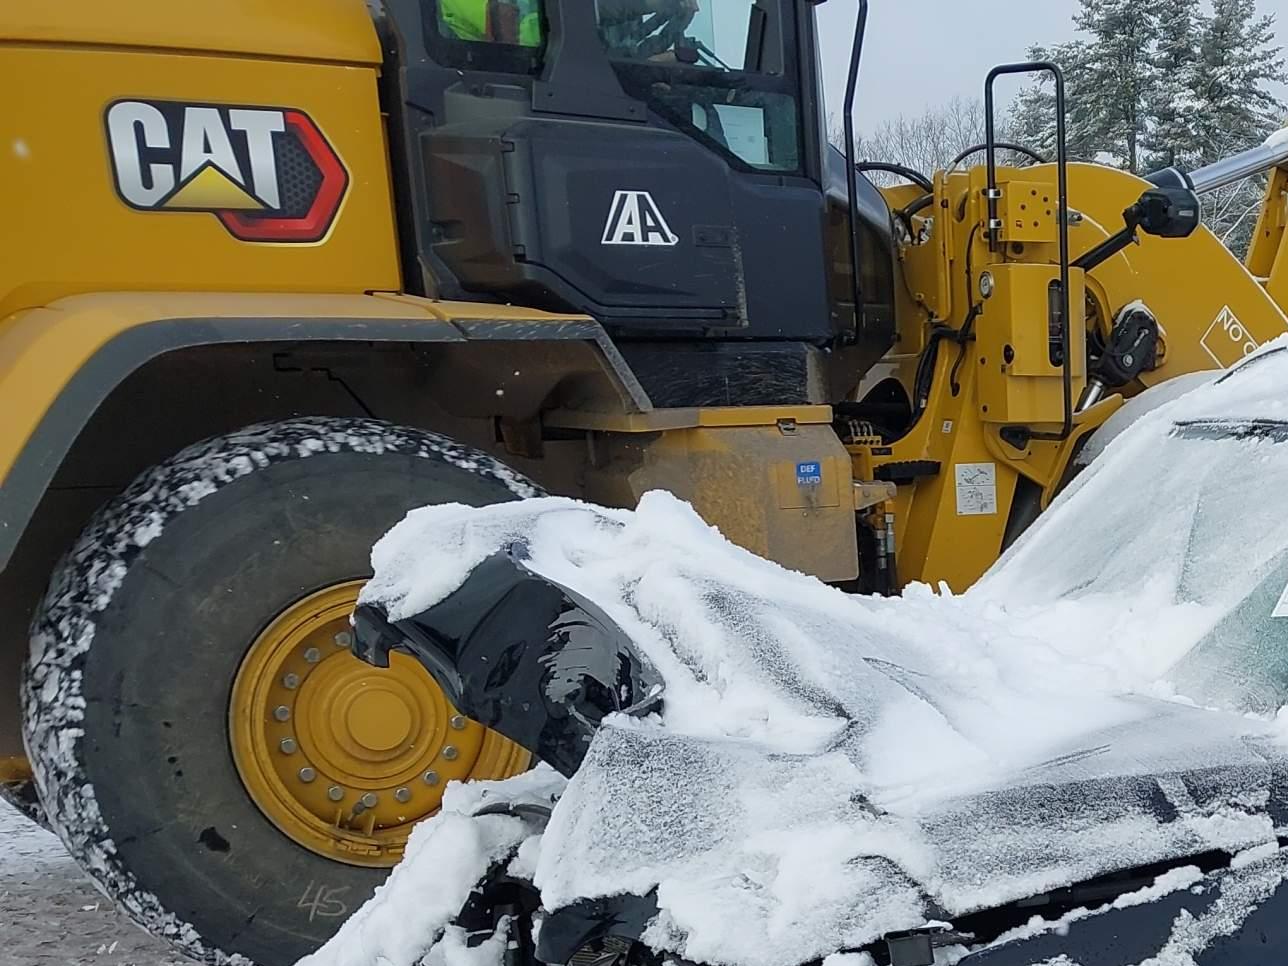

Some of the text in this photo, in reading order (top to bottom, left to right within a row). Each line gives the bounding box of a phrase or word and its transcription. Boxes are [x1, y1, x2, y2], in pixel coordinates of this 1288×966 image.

[107, 100, 286, 211] CAT
[1217, 310, 1243, 342] NO
[799, 464, 816, 473] DEF
[296, 880, 352, 922] 45
